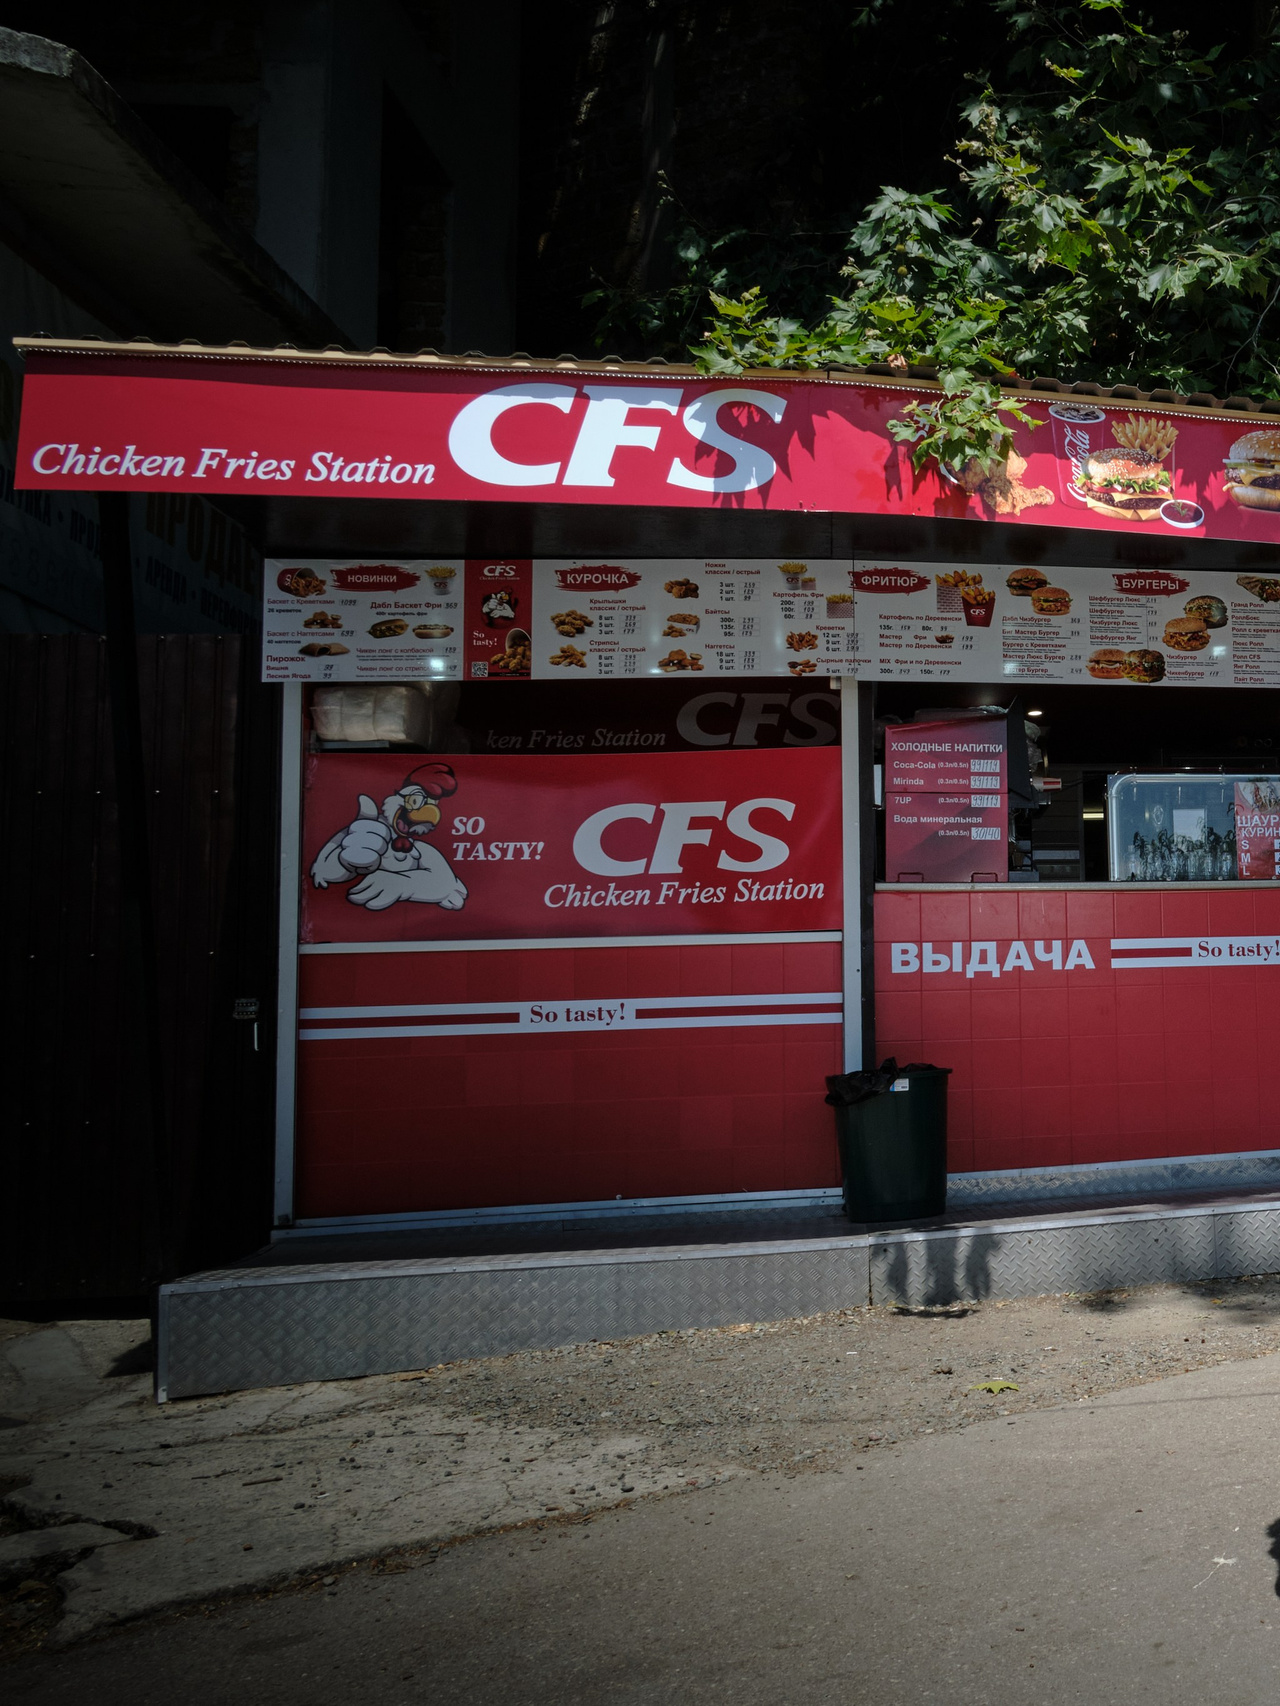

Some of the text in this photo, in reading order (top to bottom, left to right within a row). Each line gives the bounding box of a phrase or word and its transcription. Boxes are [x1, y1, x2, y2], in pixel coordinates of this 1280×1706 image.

[449, 382, 789, 493] CFS
[32, 443, 436, 485] Chicken Fries Station
[484, 566, 516, 576] CFS
[348, 575, 397, 583] НОВИНКИ
[567, 574, 629, 583] КУРОЧКА
[862, 576, 918, 586] ФРИТЮР
[1123, 579, 1179, 590] БУРГЕРЫ
[473, 638, 497, 647] tasty!
[676, 692, 841, 747] CFS
[528, 729, 585, 749] Fries
[591, 727, 666, 747] Station
[891, 743, 1003, 752] ХОЛОДНЫЕ НАПИТКИ
[893, 761, 936, 769] Coca-Cola
[893, 777, 924, 785] Mirinda
[894, 815, 918, 824] Вода
[452, 816, 485, 836] SO
[573, 797, 795, 877] CFS
[1241, 841, 1249, 849] S
[452, 840, 542, 861] TASTY!
[1241, 853, 1250, 862] M
[1243, 866, 1250, 875] L
[544, 879, 825, 907] Chicken Fries Station
[1197, 941, 1223, 958] So
[891, 942, 1095, 978] ВЫДАЧА
[530, 1003, 625, 1026] So tasty!
